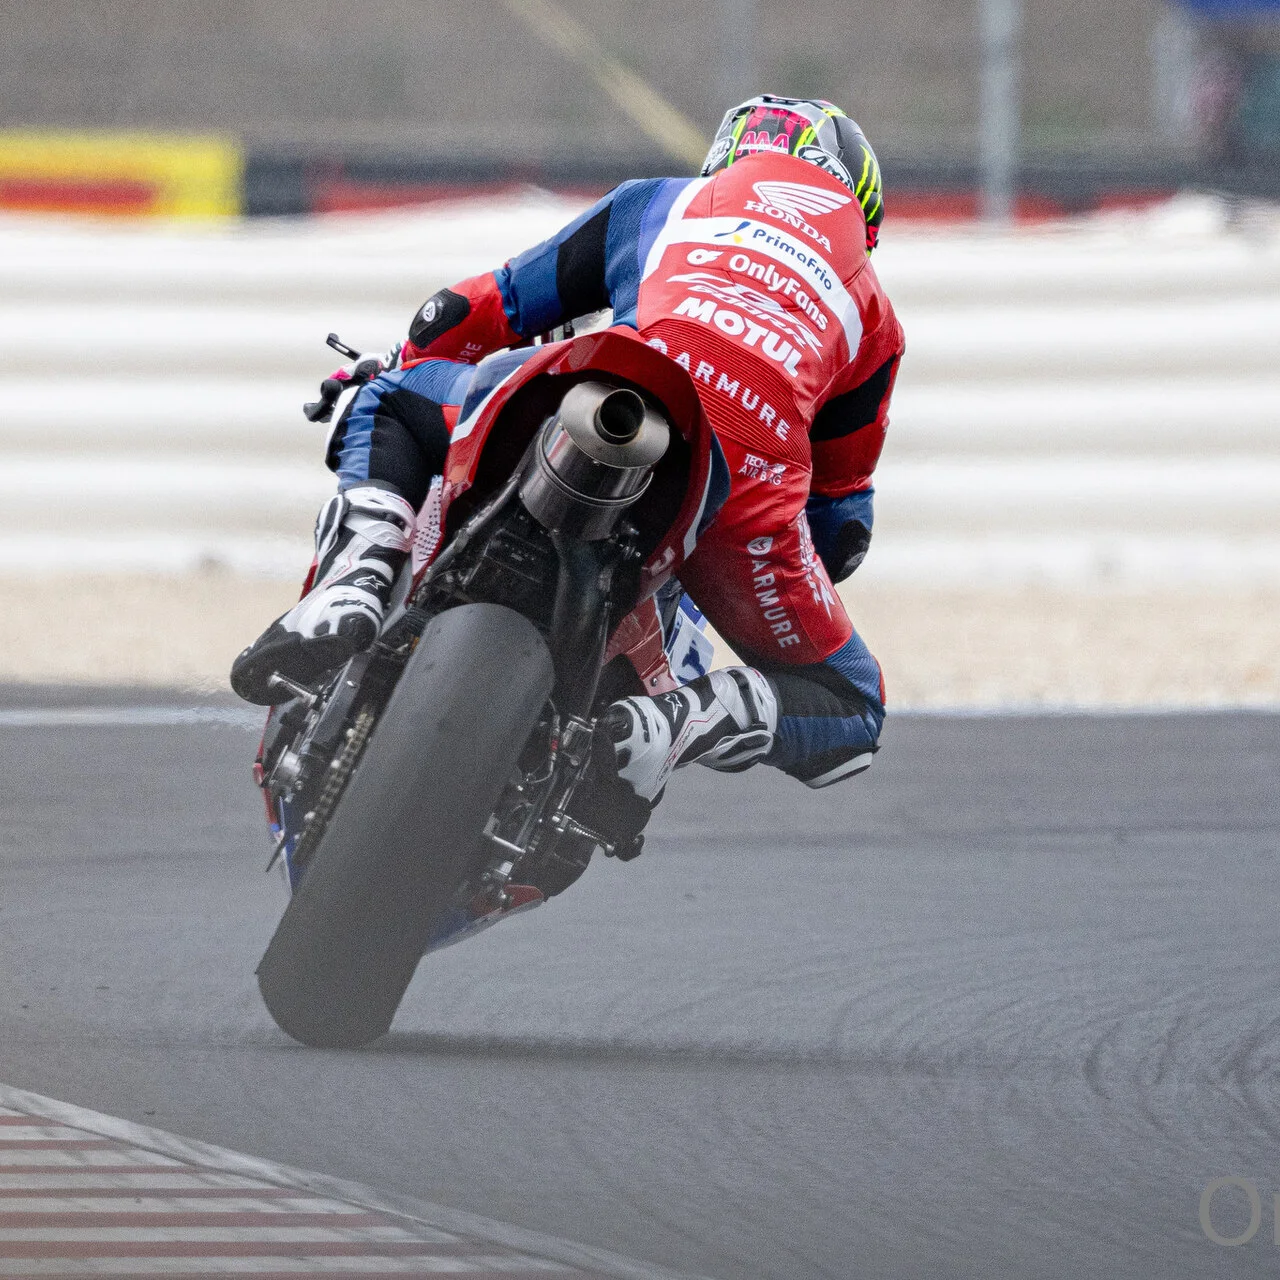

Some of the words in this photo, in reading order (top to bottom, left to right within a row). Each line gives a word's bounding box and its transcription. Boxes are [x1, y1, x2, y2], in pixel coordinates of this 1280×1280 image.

[744, 200, 832, 253] HONDA
[753, 229, 832, 290] PrimaFrio
[729, 254, 829, 332] OnlyFans
[671, 296, 804, 379] MOTUL
[674, 351, 791, 442] ARMURE
[749, 559, 801, 649] ARMURE
